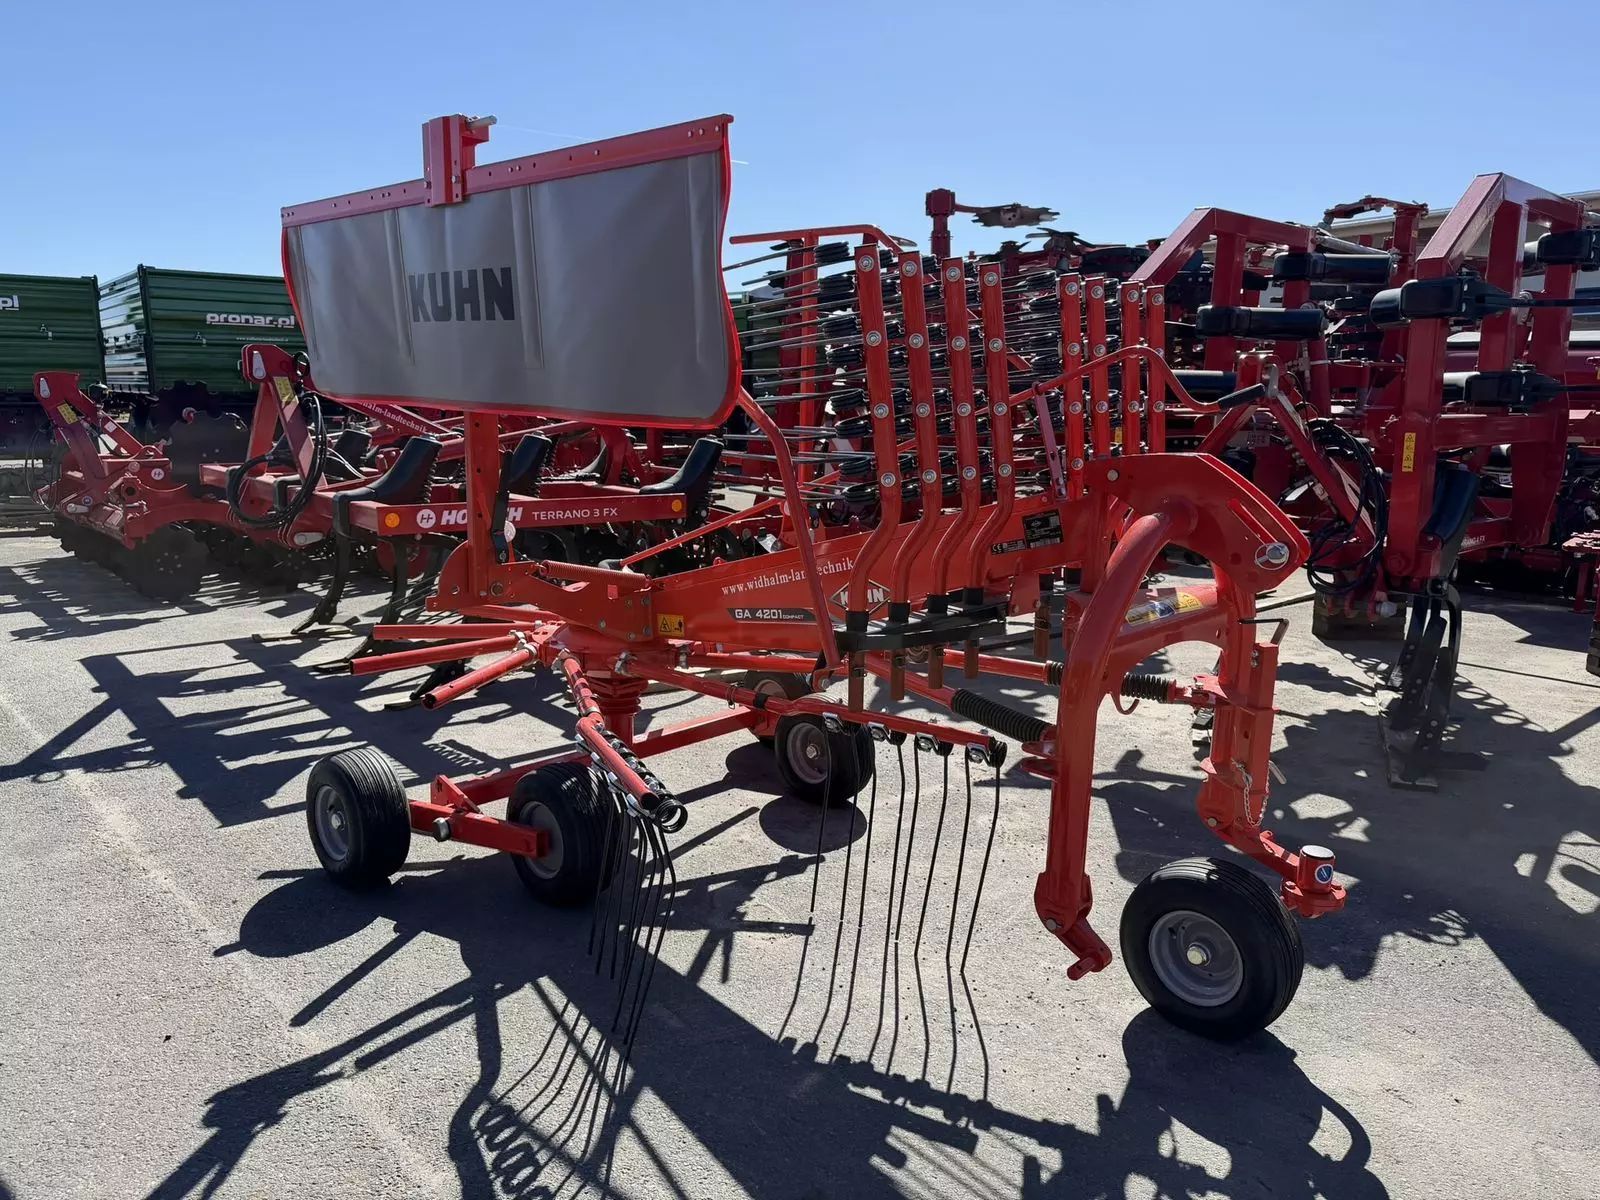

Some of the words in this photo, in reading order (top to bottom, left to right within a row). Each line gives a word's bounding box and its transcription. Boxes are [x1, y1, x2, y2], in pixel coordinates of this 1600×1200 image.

[408, 266, 515, 322] KUHN
[206, 313, 295, 328] pronar.pl
[532, 508, 590, 521] TERRANO
[593, 508, 600, 517] 3
[603, 507, 618, 517] FX
[735, 609, 751, 619] GA
[755, 609, 783, 619] 4201
